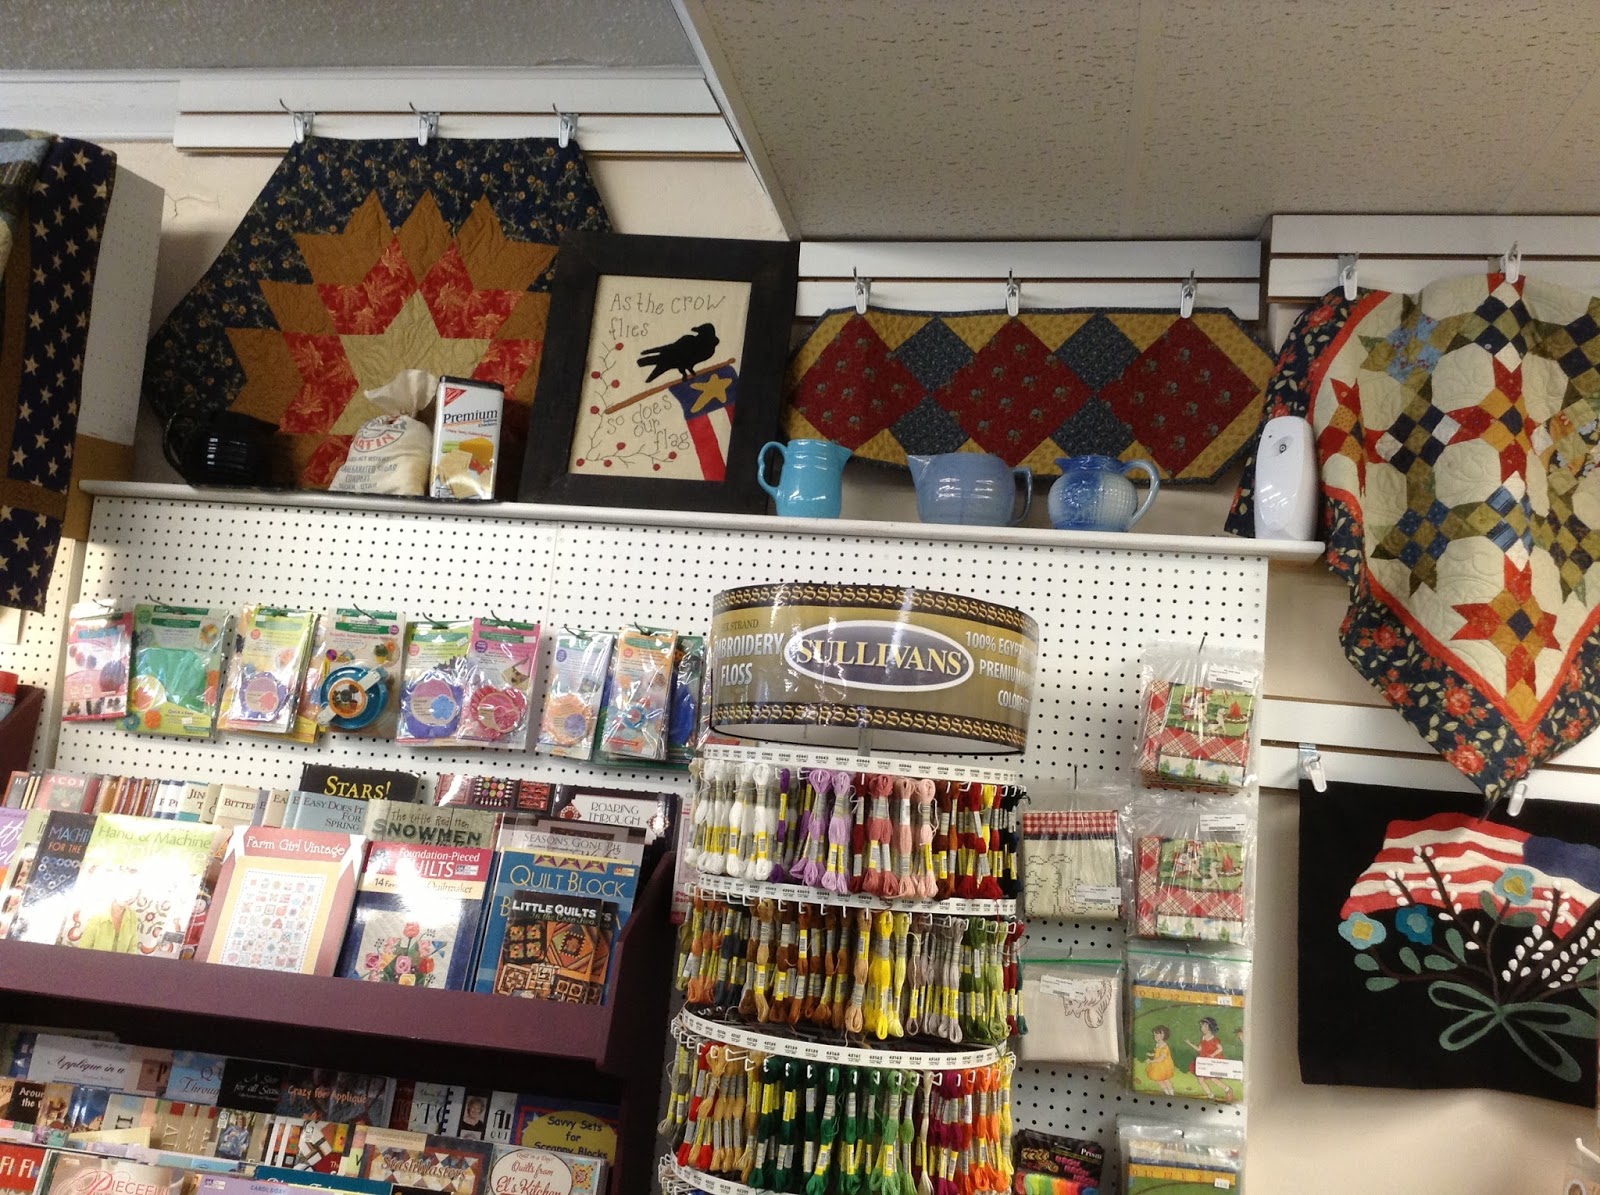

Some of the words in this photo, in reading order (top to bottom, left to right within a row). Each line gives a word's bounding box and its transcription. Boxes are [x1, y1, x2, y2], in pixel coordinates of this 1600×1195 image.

[609, 293, 631, 312] As
[637, 293, 664, 315] the
[608, 317, 649, 340] flies
[443, 410, 498, 424] Premium
[607, 415, 625, 435] so
[631, 394, 672, 424] does
[633, 418, 660, 438] our
[653, 430, 691, 451] flag
[714, 633, 785, 659] MBROIDERY
[965, 631, 997, 652] 100%
[999, 638, 1033, 660] EGYPT
[796, 639, 963, 676] SULLIVANS
[720, 663, 753, 687] FLOSS
[979, 659, 1024, 683] PREMIUM
[324, 775, 391, 800] STARS!
[303, 797, 327, 808] EASY
[327, 801, 353, 811] DOES
[353, 805, 365, 814] IT
[590, 801, 639, 815] ROARING
[325, 818, 360, 831] SPRING
[342, 812, 361, 822] FOR
[391, 809, 407, 821] The
[435, 815, 450, 827] Red
[588, 813, 641, 826] THROUGH
[154, 832, 212, 849] Machine
[371, 818, 482, 846] SNOWMEN
[524, 832, 568, 846] SEASONS
[48, 841, 66, 851] FOR
[68, 844, 82, 854] THE
[246, 835, 275, 849] Farm
[278, 838, 302, 852] Girl
[304, 840, 346, 858] Vintage
[375, 878, 385, 887] 14
[510, 864, 564, 890] QUILT
[567, 871, 626, 898] BLOCK
[512, 900, 554, 914] LITTLE
[554, 904, 597, 919] QUILTS
[288, 1085, 312, 1101] Crazy
[314, 1087, 328, 1099] for
[21, 1097, 35, 1108] the
[547, 1115, 577, 1130] Savvy
[580, 1120, 603, 1132] Sets
[565, 1131, 582, 1142] for
[578, 1146, 608, 1160] Blocks
[511, 1160, 535, 1173] Quilts
[534, 1163, 554, 1178] from
[496, 1175, 517, 1193] El's
[520, 1178, 562, 1195] Kitchen
